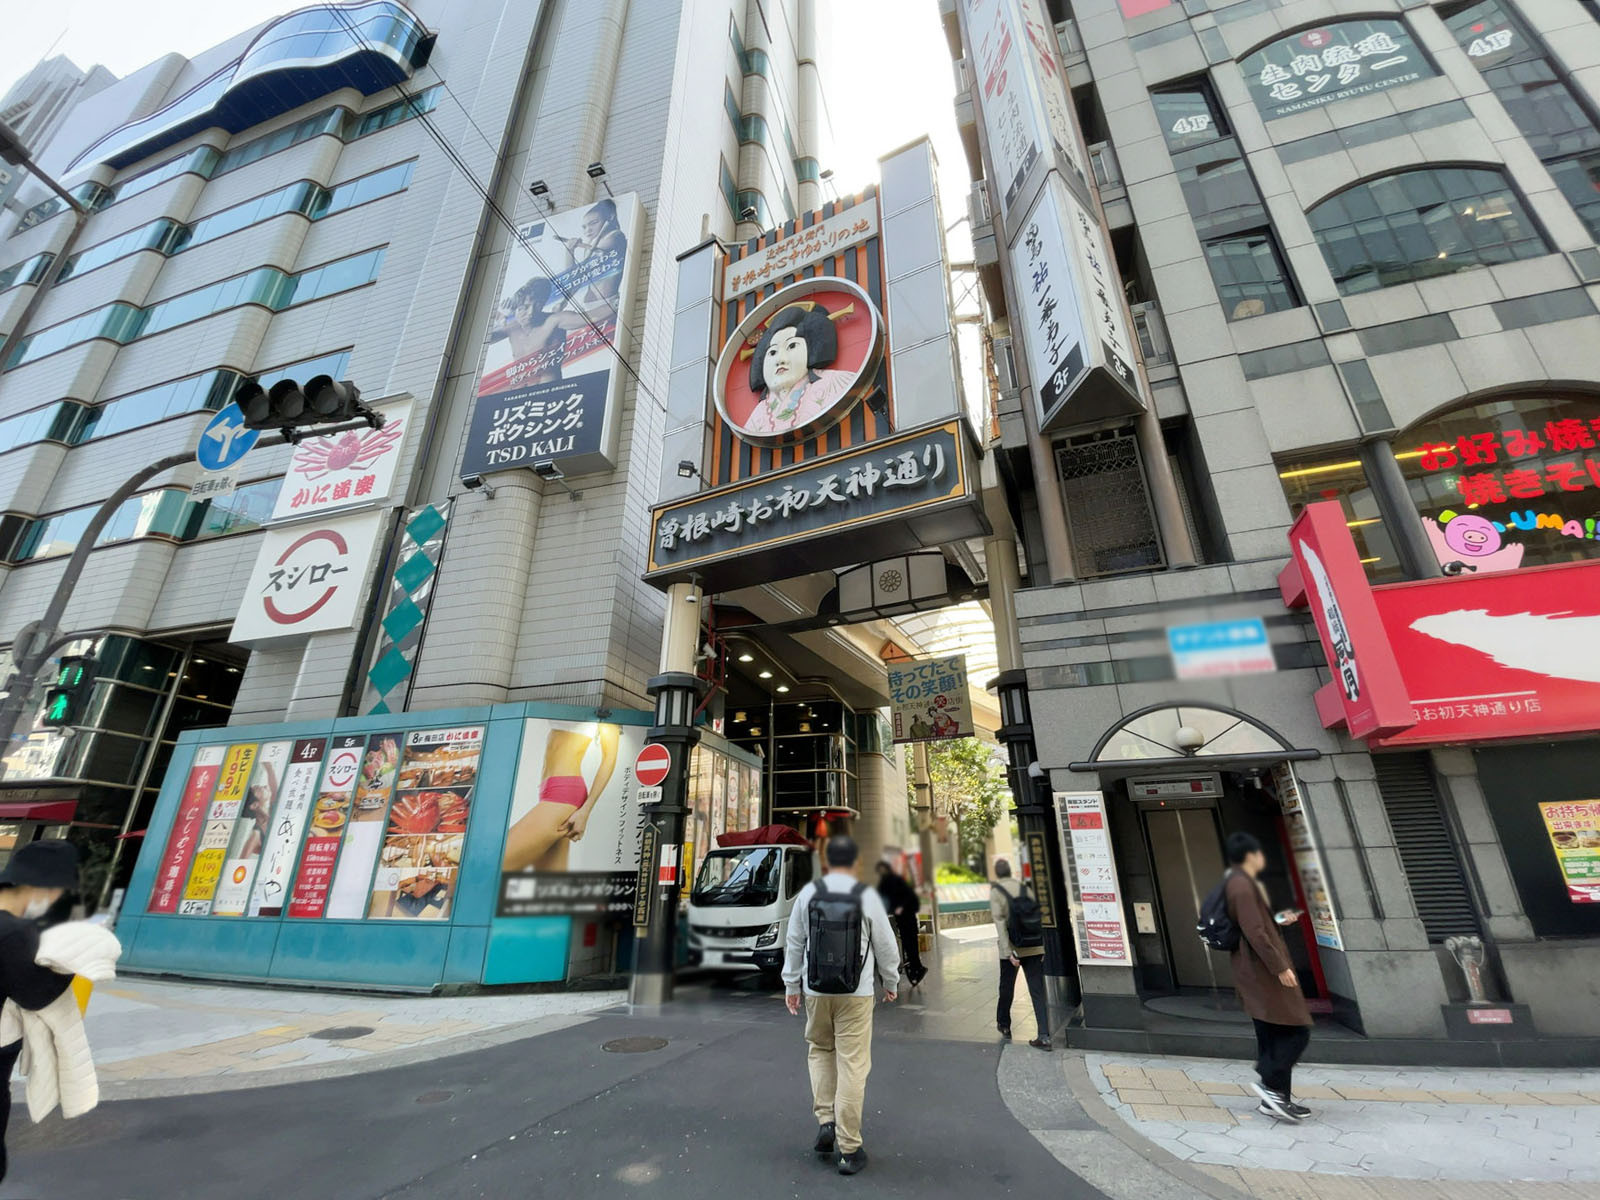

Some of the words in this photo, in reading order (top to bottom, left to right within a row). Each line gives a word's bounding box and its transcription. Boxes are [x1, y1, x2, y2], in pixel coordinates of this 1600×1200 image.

[1260, 32, 1400, 86] 生肉流通
[1468, 29, 1513, 59] 4F
[1270, 55, 1408, 100] センター
[1276, 93, 1335, 115] NAMANIKU
[1337, 84, 1374, 99] RYUTU
[1375, 73, 1419, 89] CENTER
[1172, 113, 1211, 135] 4F
[1052, 366, 1070, 395] 3F
[493, 393, 583, 426] リズミック
[486, 445, 526, 465] TSD
[529, 435, 576, 458] KALI
[290, 475, 376, 508] かに道楽
[658, 444, 945, 549] 曽根崎お初天神通り
[261, 562, 349, 593] スシロー
[889, 657, 960, 689] 待ってたで
[300, 743, 317, 758] 4F
[344, 738, 356, 747] 5F
[231, 748, 253, 795] 生ビール
[328, 765, 357, 775] スシロー
